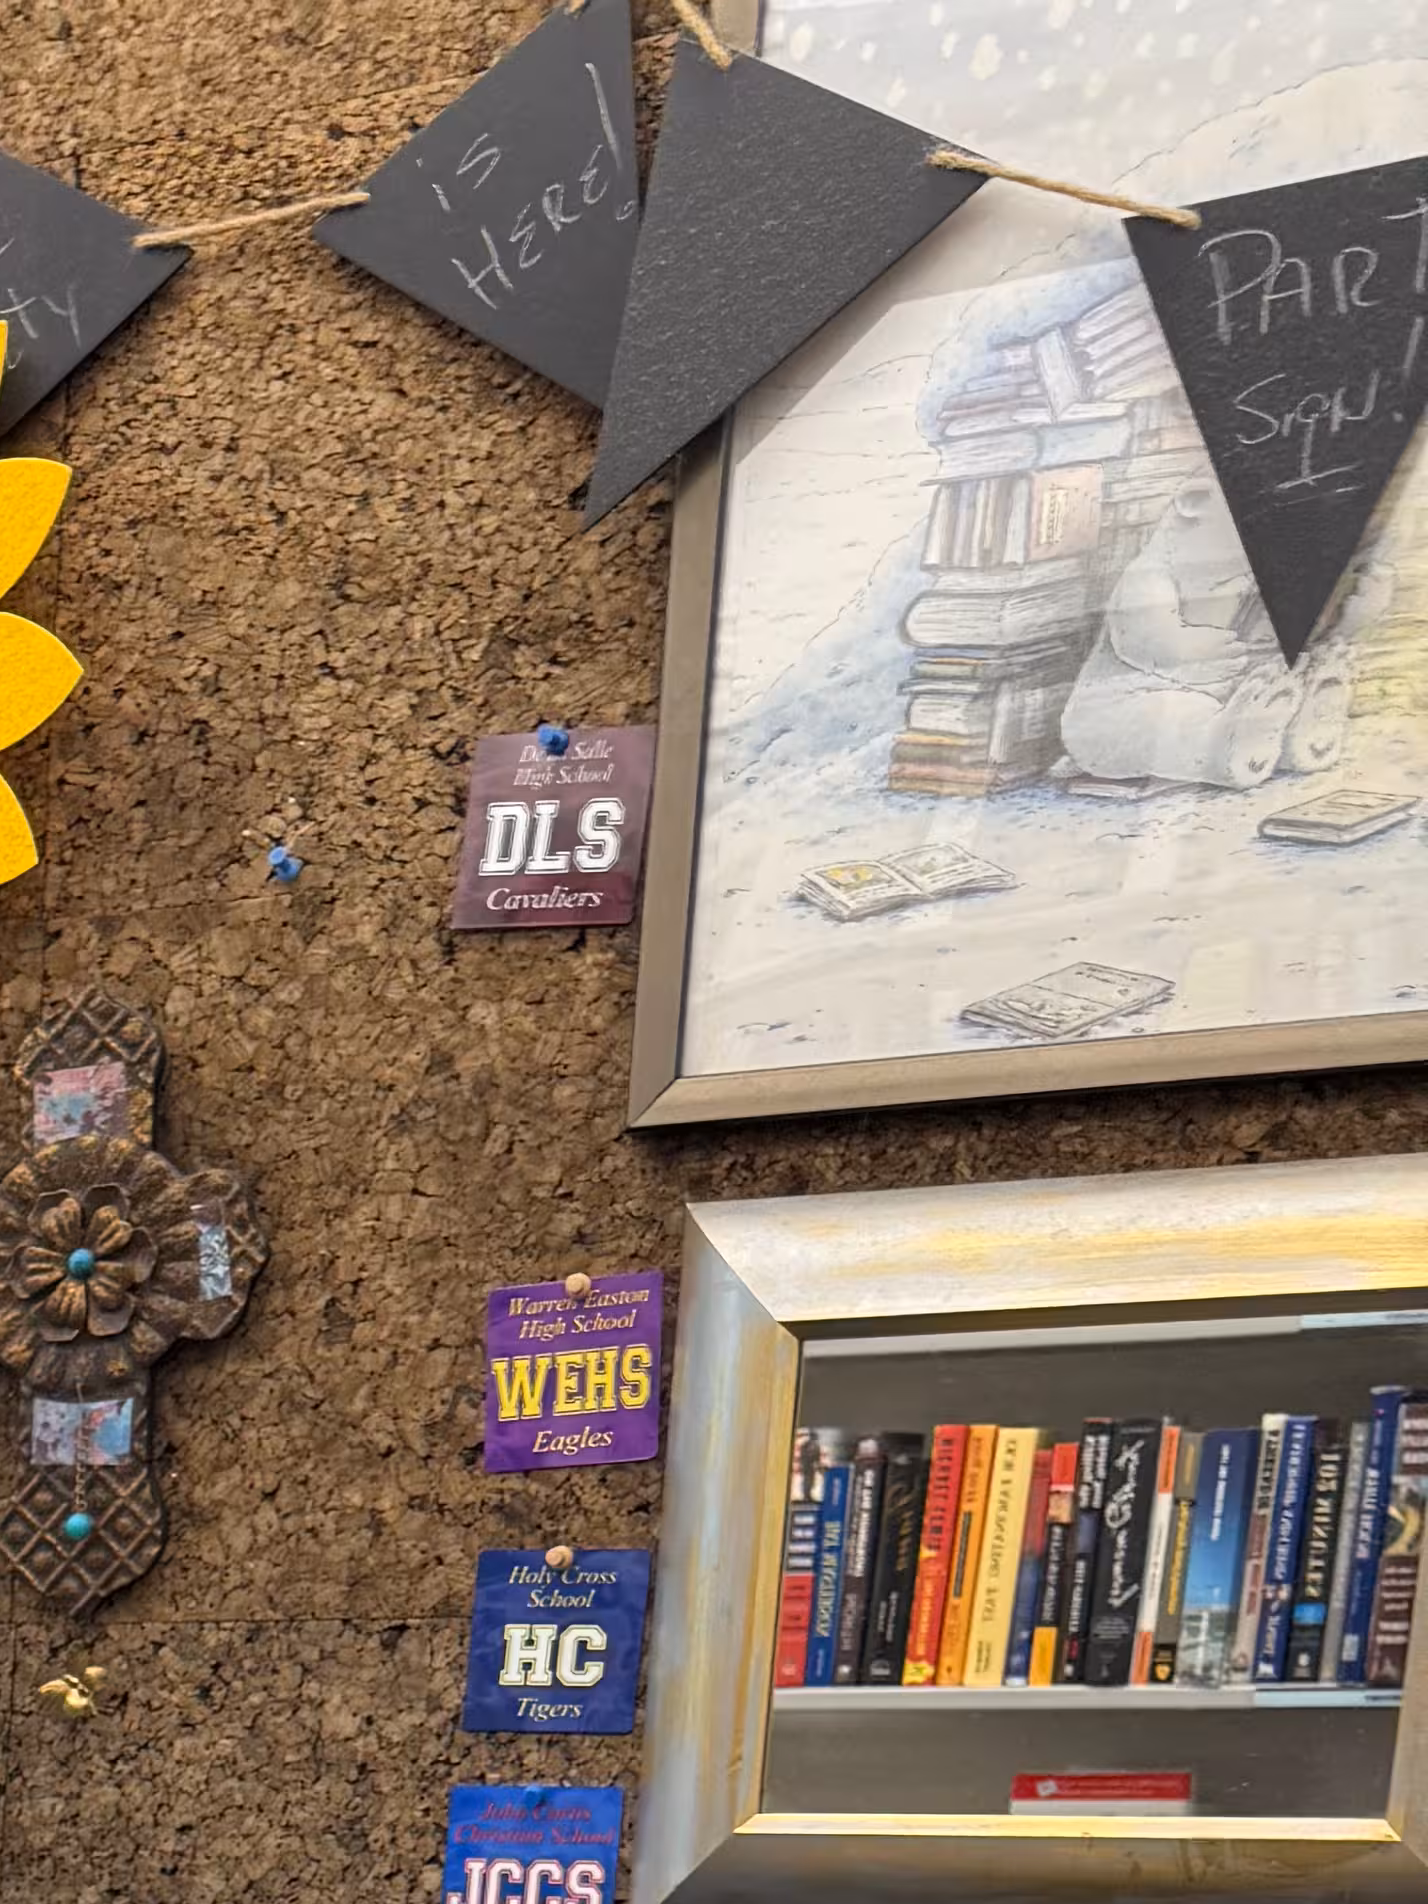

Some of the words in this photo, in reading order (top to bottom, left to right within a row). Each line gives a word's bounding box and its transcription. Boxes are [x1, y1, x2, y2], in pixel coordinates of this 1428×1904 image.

[513, 768, 554, 790] High
[556, 763, 615, 785] School
[478, 797, 626, 876] DLS
[486, 885, 604, 911] Cavaliers
[508, 1295, 577, 1316] Warren
[519, 1318, 566, 1341] High
[571, 1309, 637, 1333] School
[491, 1344, 652, 1422] WEHS
[533, 1426, 613, 1456] Eagles
[508, 1565, 554, 1591] Holy
[560, 1566, 618, 1585] Cross
[527, 1590, 595, 1608] School
[498, 1623, 608, 1687] HC
[516, 1697, 584, 1722] Tigers
